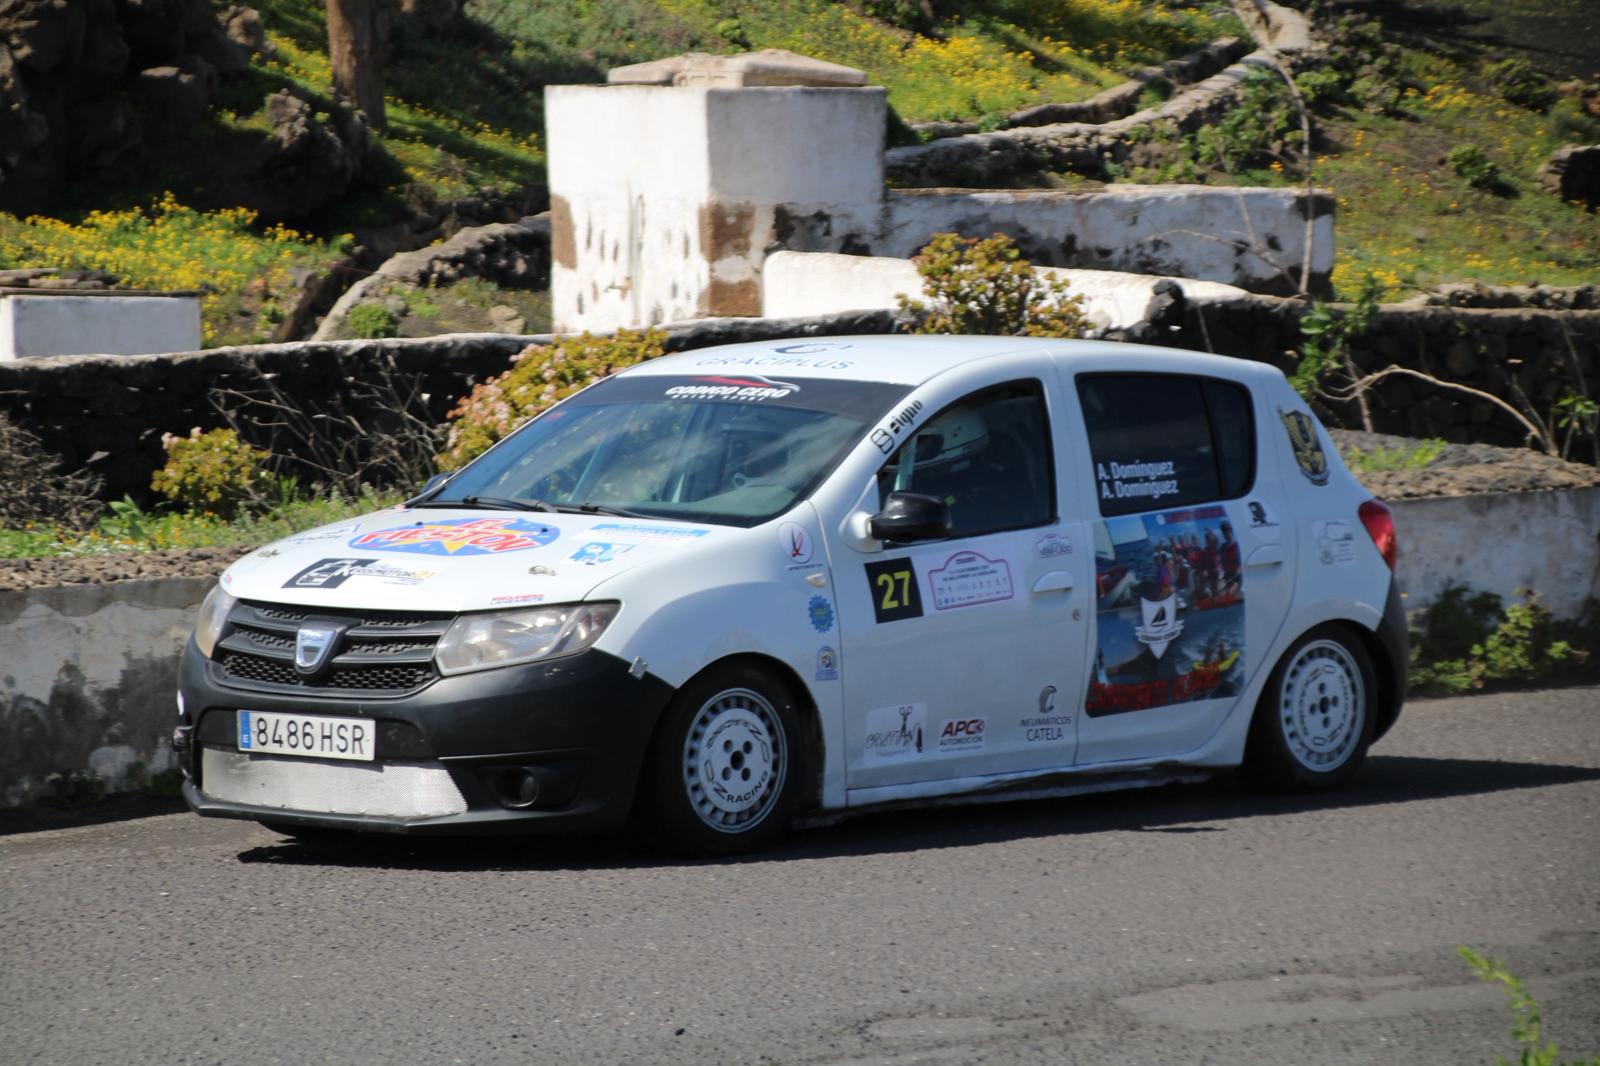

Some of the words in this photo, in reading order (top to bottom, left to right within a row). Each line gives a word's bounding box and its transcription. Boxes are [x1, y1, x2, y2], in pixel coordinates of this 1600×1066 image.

[696, 358, 855, 369] GRACIPLUS
[664, 385, 740, 396] CODIGO
[736, 387, 791, 399] CERO
[1098, 463, 1111, 480] A.
[1102, 482, 1115, 498] A.
[876, 571, 911, 610] 27
[256, 717, 315, 750] 8486
[320, 721, 365, 755] HSR
[1026, 728, 1064, 742] CATELA
[727, 770, 768, 803] RACING
